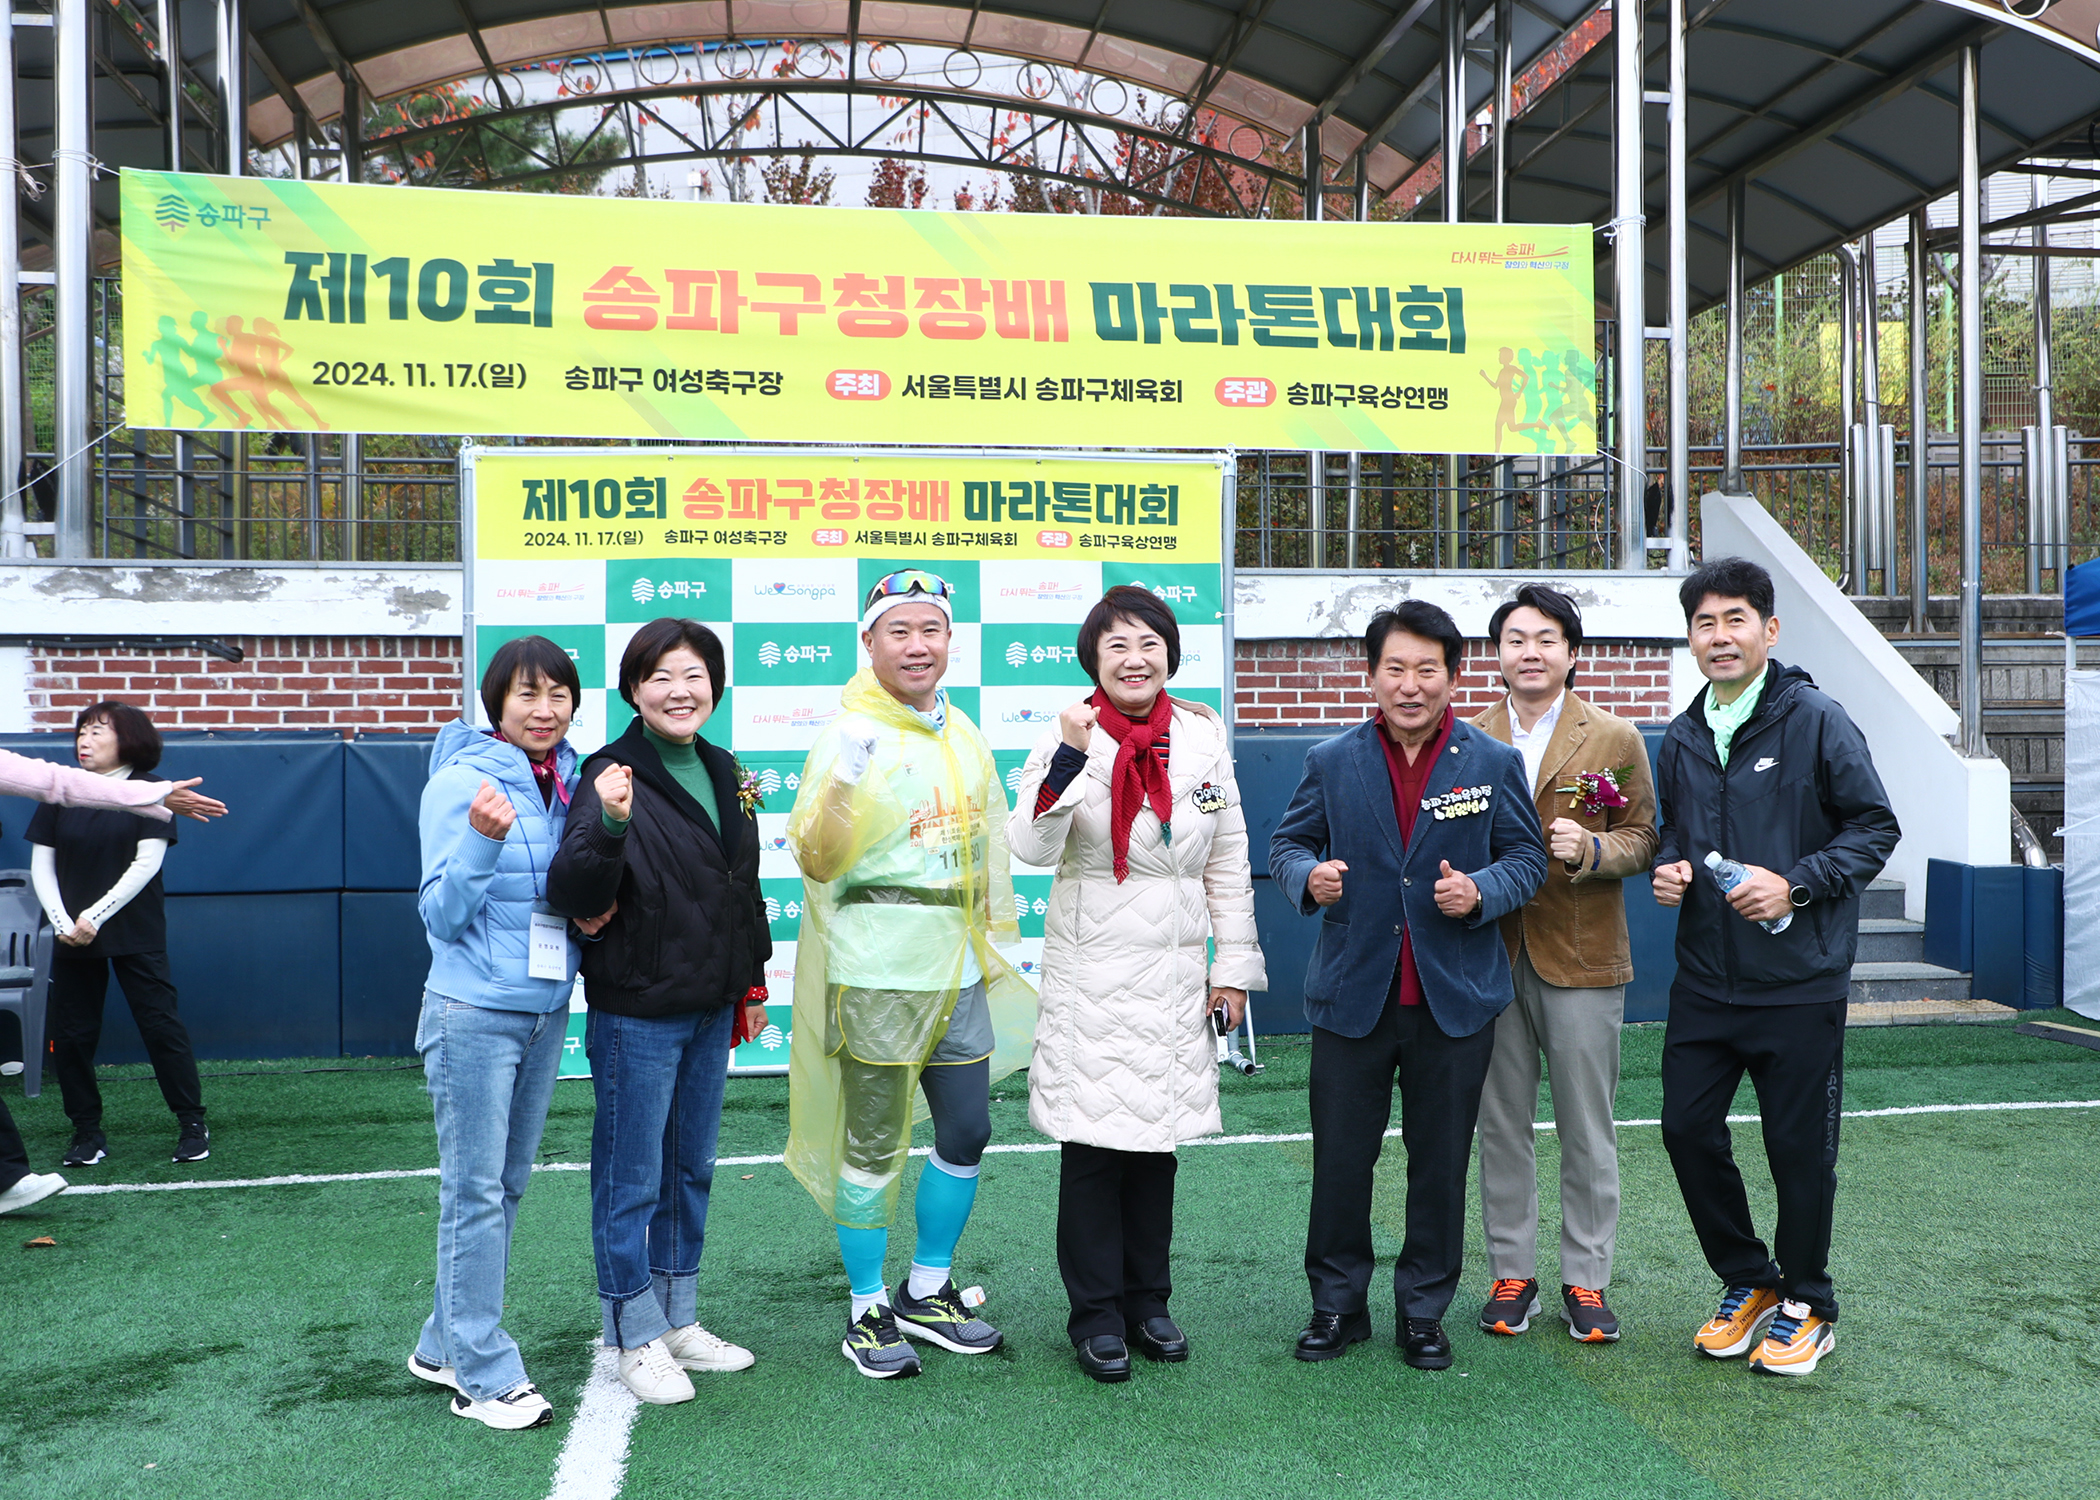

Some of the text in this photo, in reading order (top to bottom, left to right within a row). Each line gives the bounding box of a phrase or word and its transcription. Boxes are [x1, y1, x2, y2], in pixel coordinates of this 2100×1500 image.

[195, 203, 271, 231] 송파구
[1451, 251, 1503, 264] 다시 뛰는
[1506, 243, 1535, 256] 송파!
[283, 250, 1466, 354] 제10회 송파구청장배 마라톤대회
[312, 361, 1449, 410] 2024. 11. 17.(일) 송파구 여성축구장 주최 서울특별시 송파구체육회 주관 송파구육상연맹
[522, 476, 1179, 526] 제10회 송파구청장배 마라톤대회
[524, 529, 1177, 550] 2024. 11. 17.(일) 송파구 여성축구장 주최 서울특별시 송파구체육회 주관 송파구육상연맹
[657, 580, 707, 599] 송파구
[754, 584, 836, 601] We Songpa
[1152, 585, 1198, 603] 송파구
[783, 645, 833, 663] 송파구
[1030, 645, 1078, 664] 송파구
